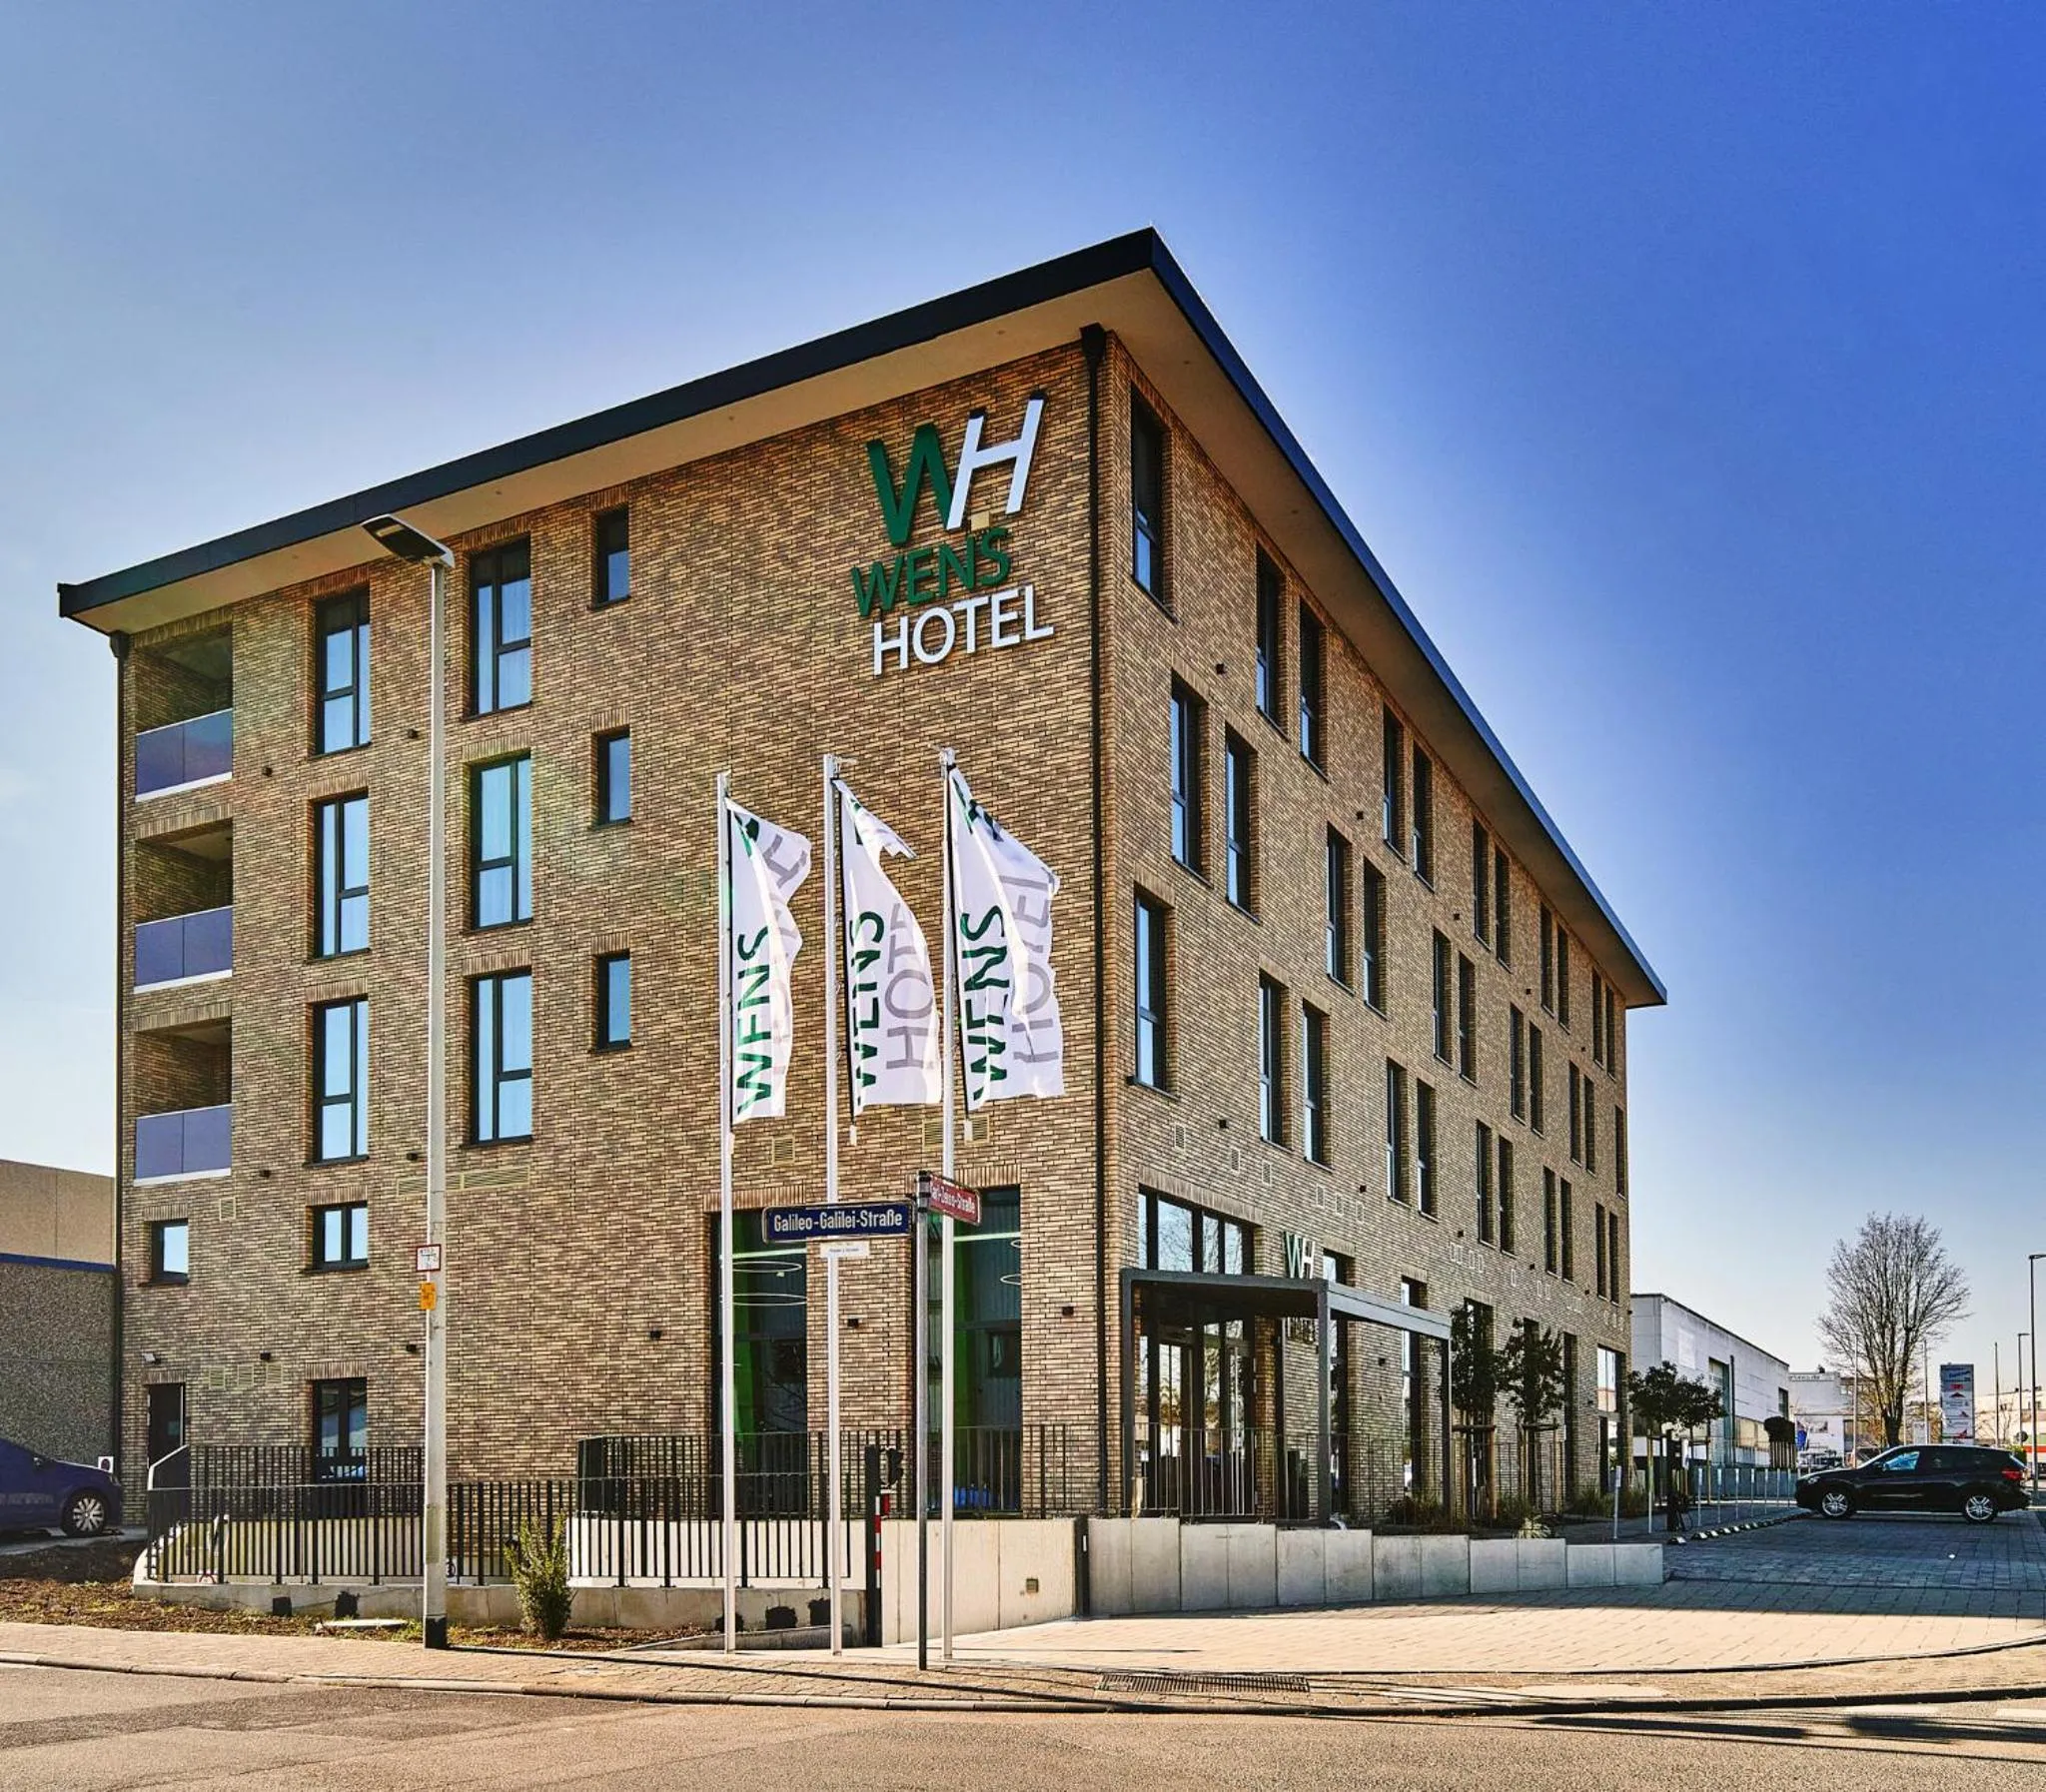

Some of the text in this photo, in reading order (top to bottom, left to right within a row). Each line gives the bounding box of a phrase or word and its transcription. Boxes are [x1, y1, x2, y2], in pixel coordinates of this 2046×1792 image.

[866, 391, 1045, 547] WH
[851, 526, 1012, 616] WENS
[873, 583, 1055, 676] HOTEL
[773, 1209, 903, 1232] Galileo-Galilei-Straße
